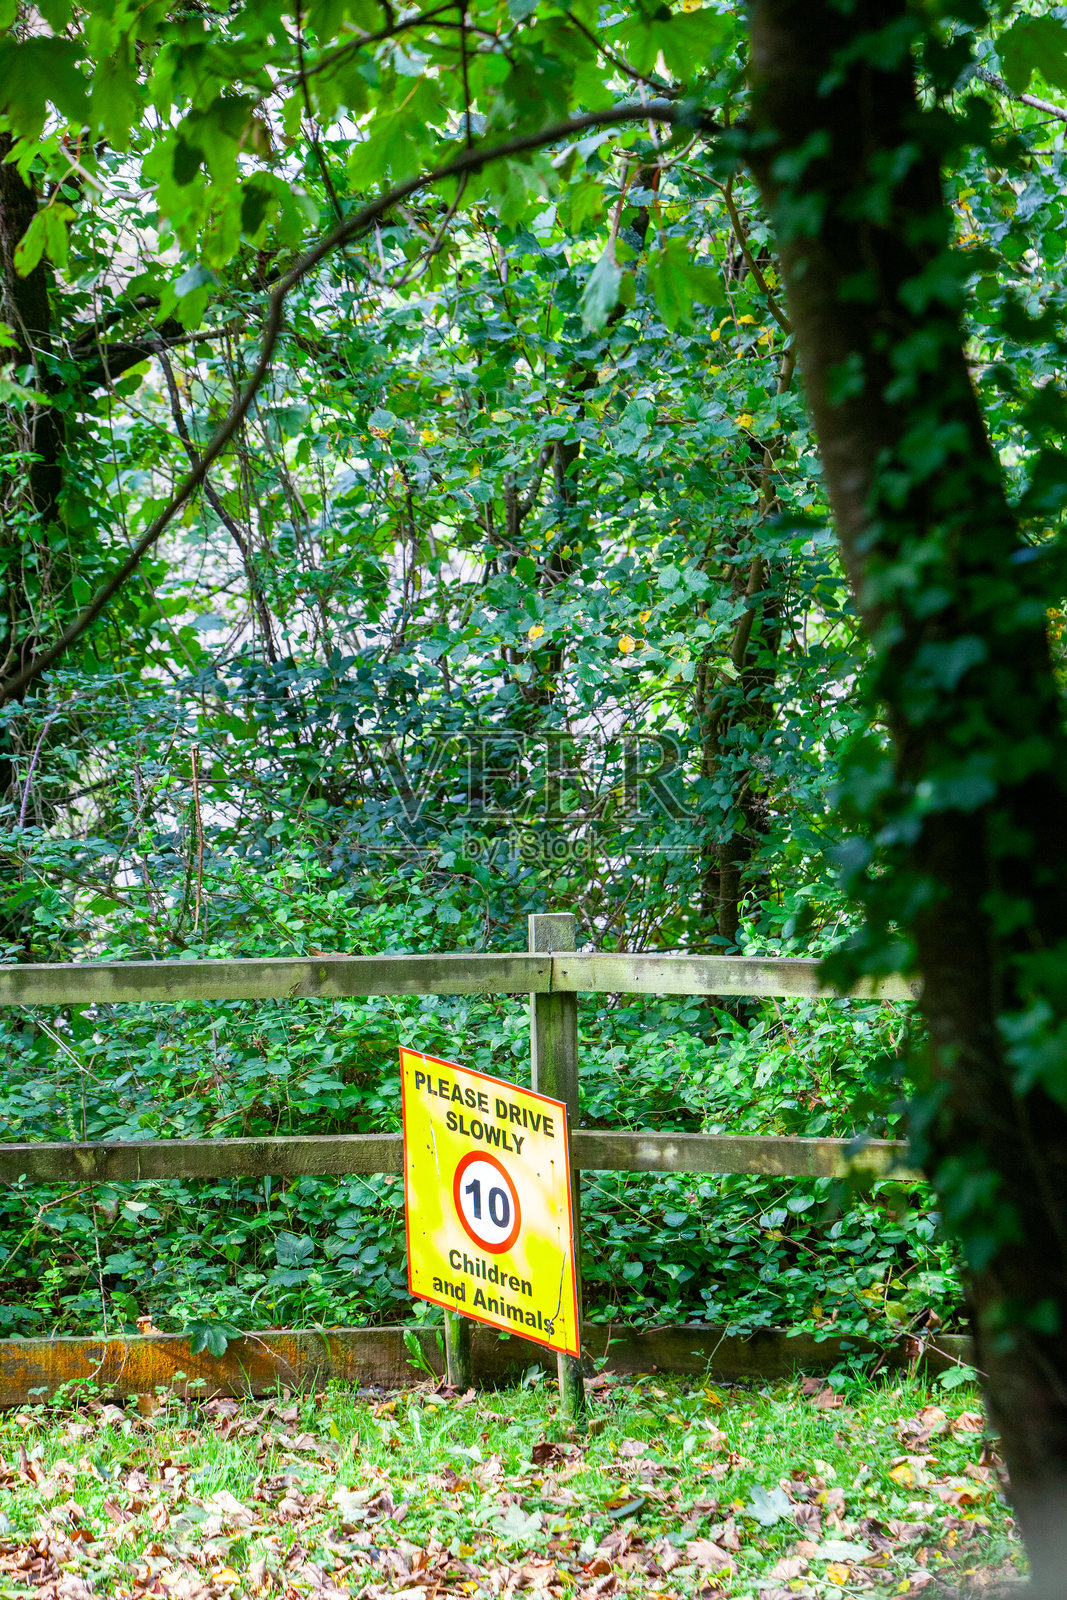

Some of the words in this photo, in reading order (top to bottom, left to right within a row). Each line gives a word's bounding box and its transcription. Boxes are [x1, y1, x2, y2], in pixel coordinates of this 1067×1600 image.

[414, 1070, 489, 1114] PLEASE
[495, 1098, 555, 1138] DRIVE
[446, 1111, 525, 1155] SLOWLY
[465, 1178, 511, 1228] 10
[449, 1249, 533, 1297] Children
[432, 1276, 466, 1302] and
[473, 1289, 556, 1336] Animals
